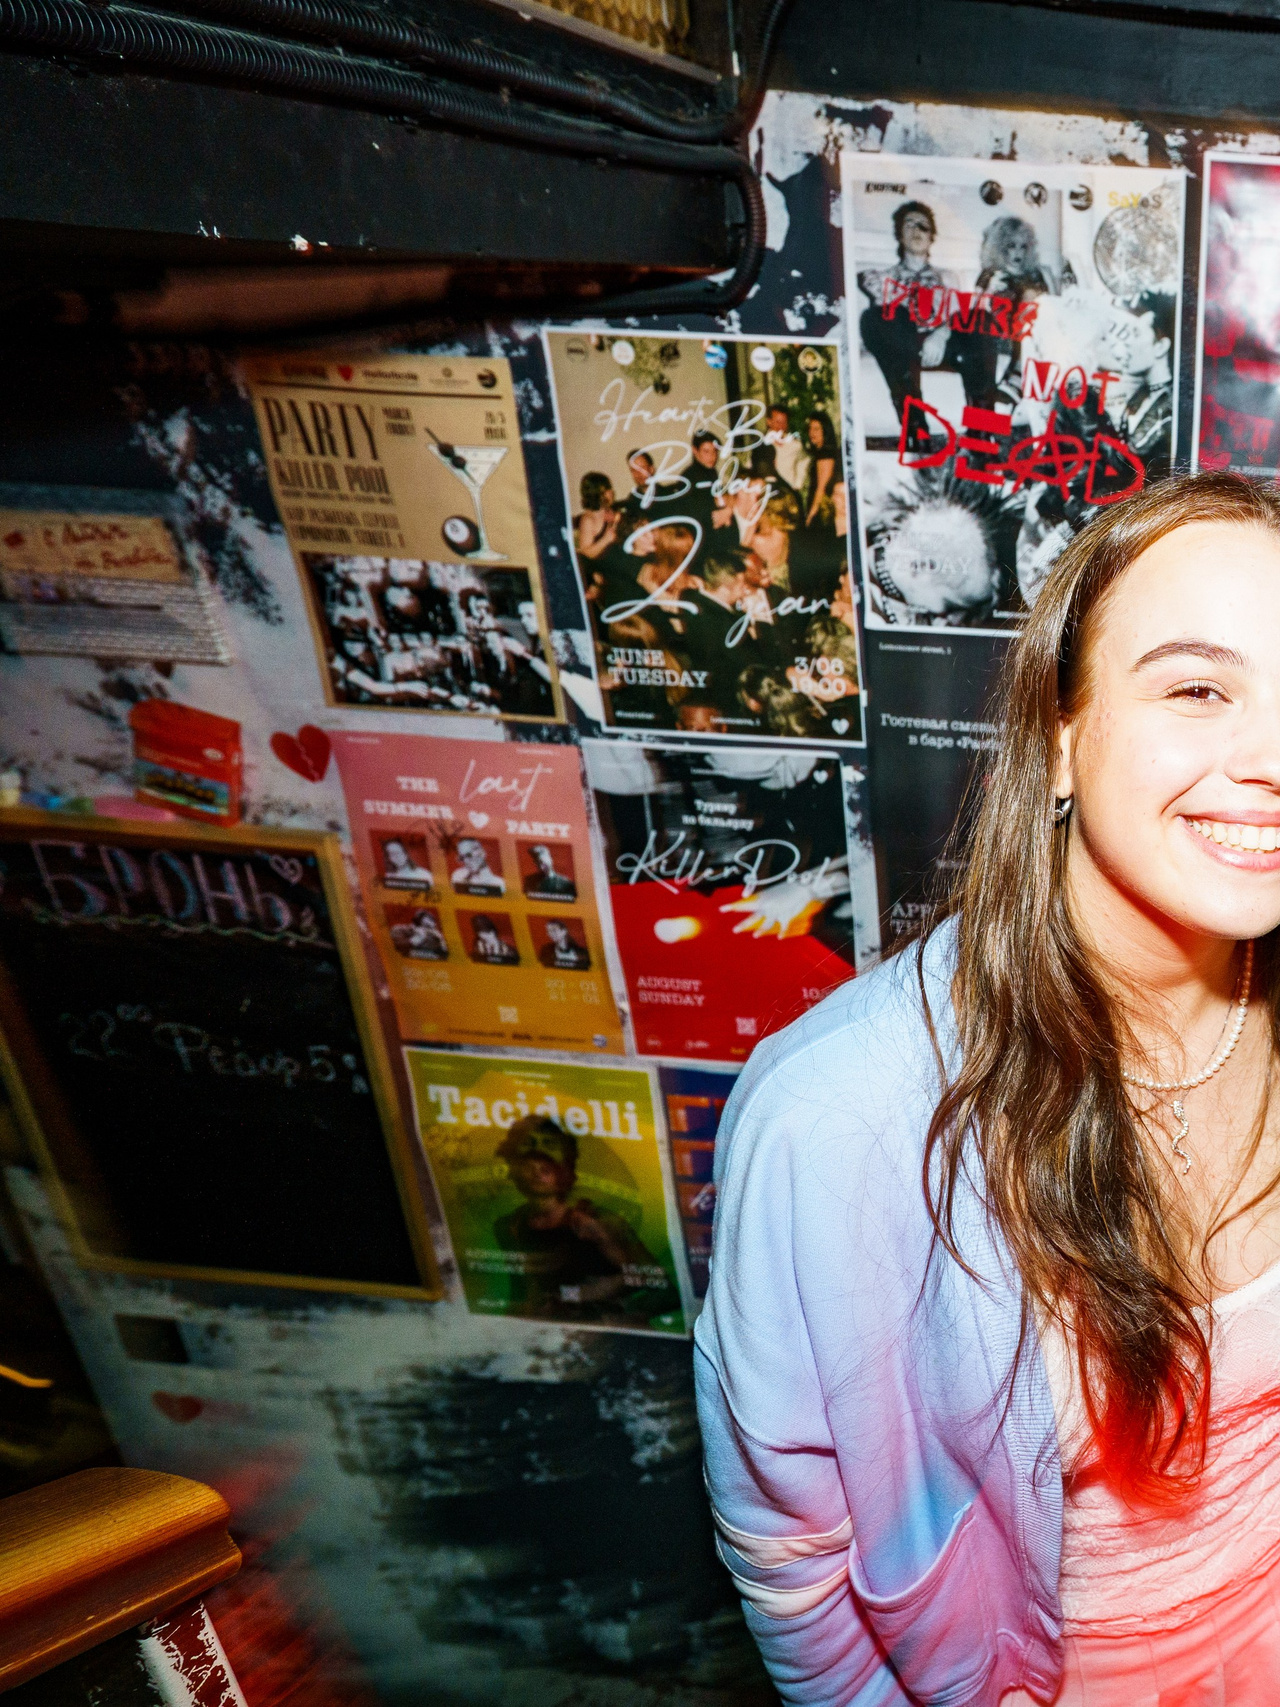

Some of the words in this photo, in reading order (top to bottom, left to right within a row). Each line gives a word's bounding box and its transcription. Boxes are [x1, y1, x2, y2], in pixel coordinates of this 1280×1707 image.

[1021, 357, 1121, 415] NOT
[898, 395, 1146, 505] DEAD
[607, 667, 709, 687] TUESDAY
[363, 800, 454, 820] SUMMER
[506, 819, 572, 838] PARTY
